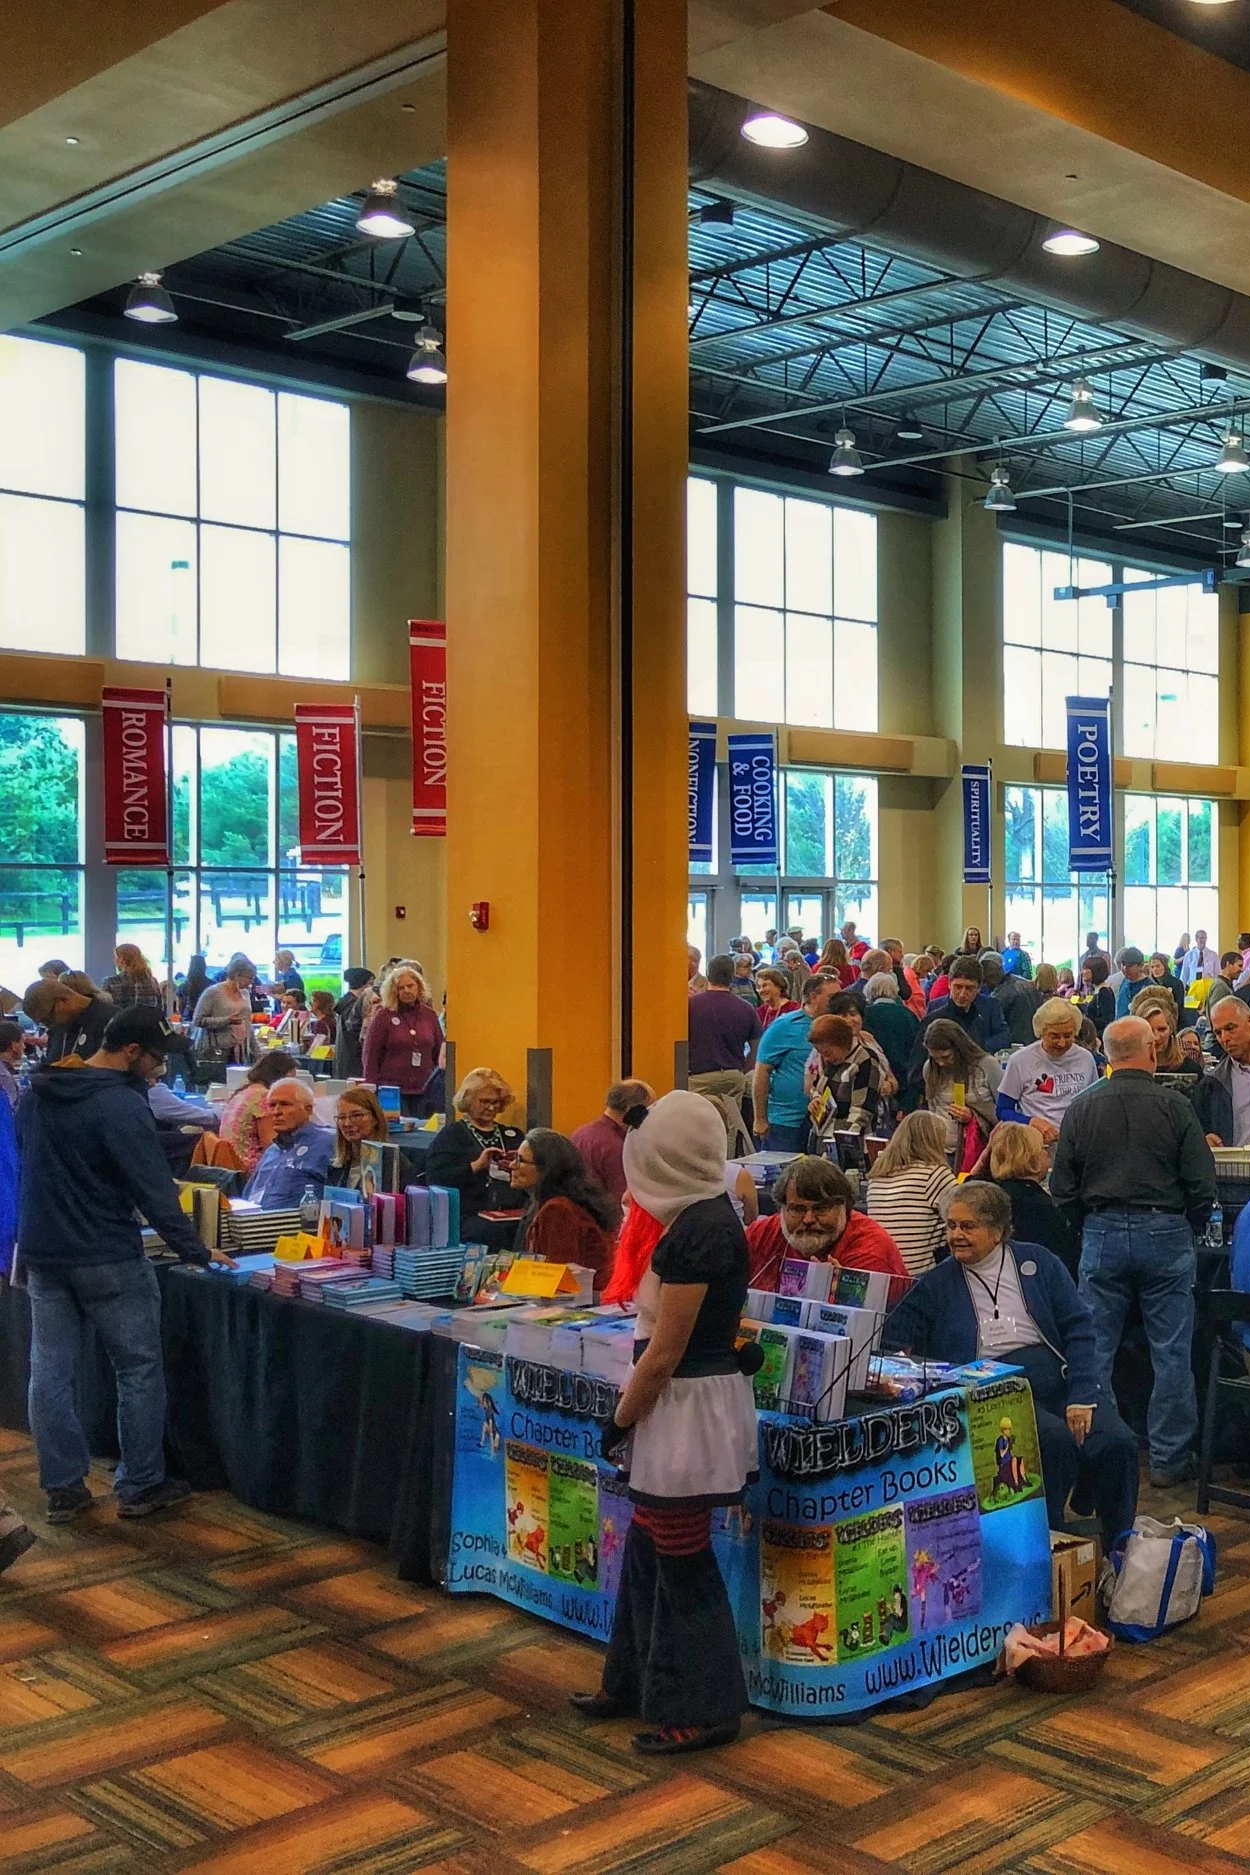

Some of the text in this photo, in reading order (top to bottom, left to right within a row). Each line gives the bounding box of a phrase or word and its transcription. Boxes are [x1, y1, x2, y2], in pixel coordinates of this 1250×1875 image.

[422, 680, 447, 786] FICTION
[121, 711, 149, 840] ROMANCE
[312, 726, 344, 843] FICTION
[732, 762, 752, 836] & FOOD
[752, 755, 773, 841] COOKING
[1077, 724, 1100, 842] POETRY
[970, 781, 981, 866] SPIRITUALITY
[1054, 1072, 1085, 1084] FRIENDS
[510, 1359, 622, 1418] WIELDE
[511, 1411, 579, 1450] Chapter
[763, 1393, 961, 1475] WIELDERS
[768, 1460, 957, 1521] Chapter Books
[450, 1561, 497, 1584] Lucas
[451, 1531, 500, 1554] Sophia
[750, 1671, 846, 1705] McWilliams
